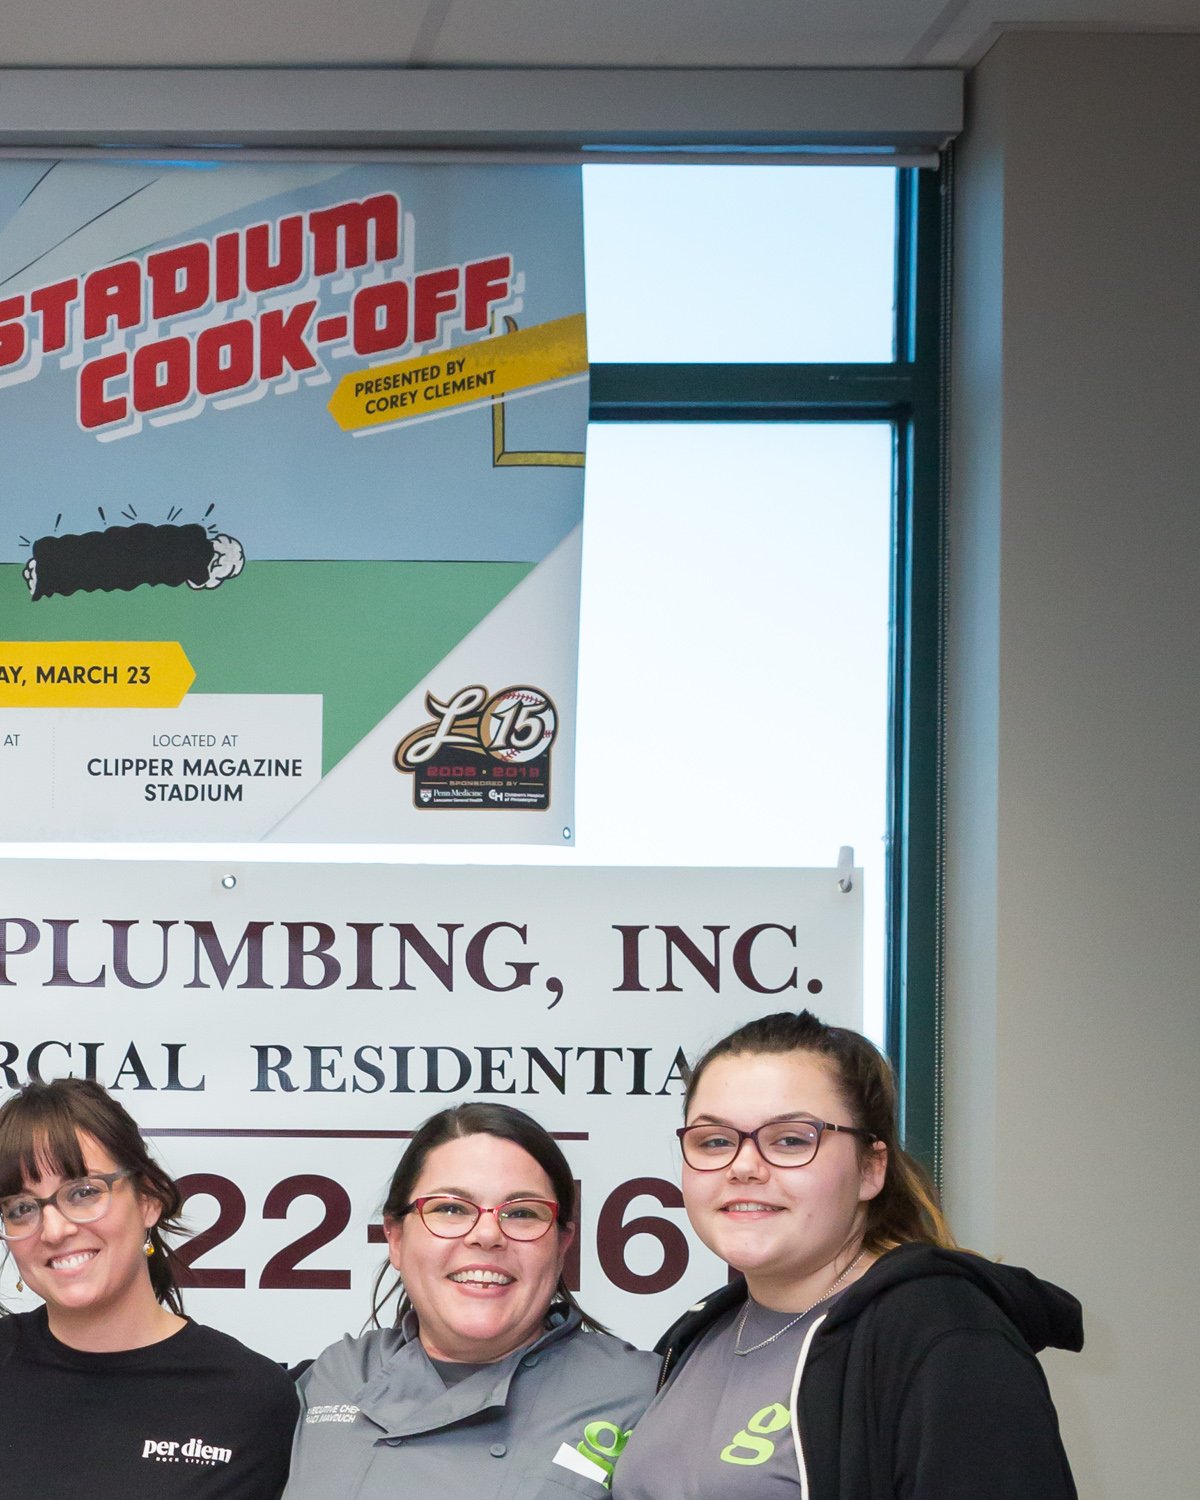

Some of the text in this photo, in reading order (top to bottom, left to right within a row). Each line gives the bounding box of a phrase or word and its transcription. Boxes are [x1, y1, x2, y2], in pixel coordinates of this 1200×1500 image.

[79, 255, 513, 430] COOK-OFF
[355, 358, 466, 397] PRESENTED BY
[365, 370, 496, 415] COREY CLEMENT
[35, 665, 119, 684] MARCH
[127, 665, 151, 684] 23
[4, 734, 21, 747] AT
[152, 734, 239, 748] LOCATED AT
[87, 758, 302, 777] CLIPPER MAGAZINE
[144, 784, 244, 802] STADIUM
[611, 922, 824, 994] INC.
[250, 1043, 688, 1096] RESIDENTIA
[142, 1438, 232, 1463] per diem
